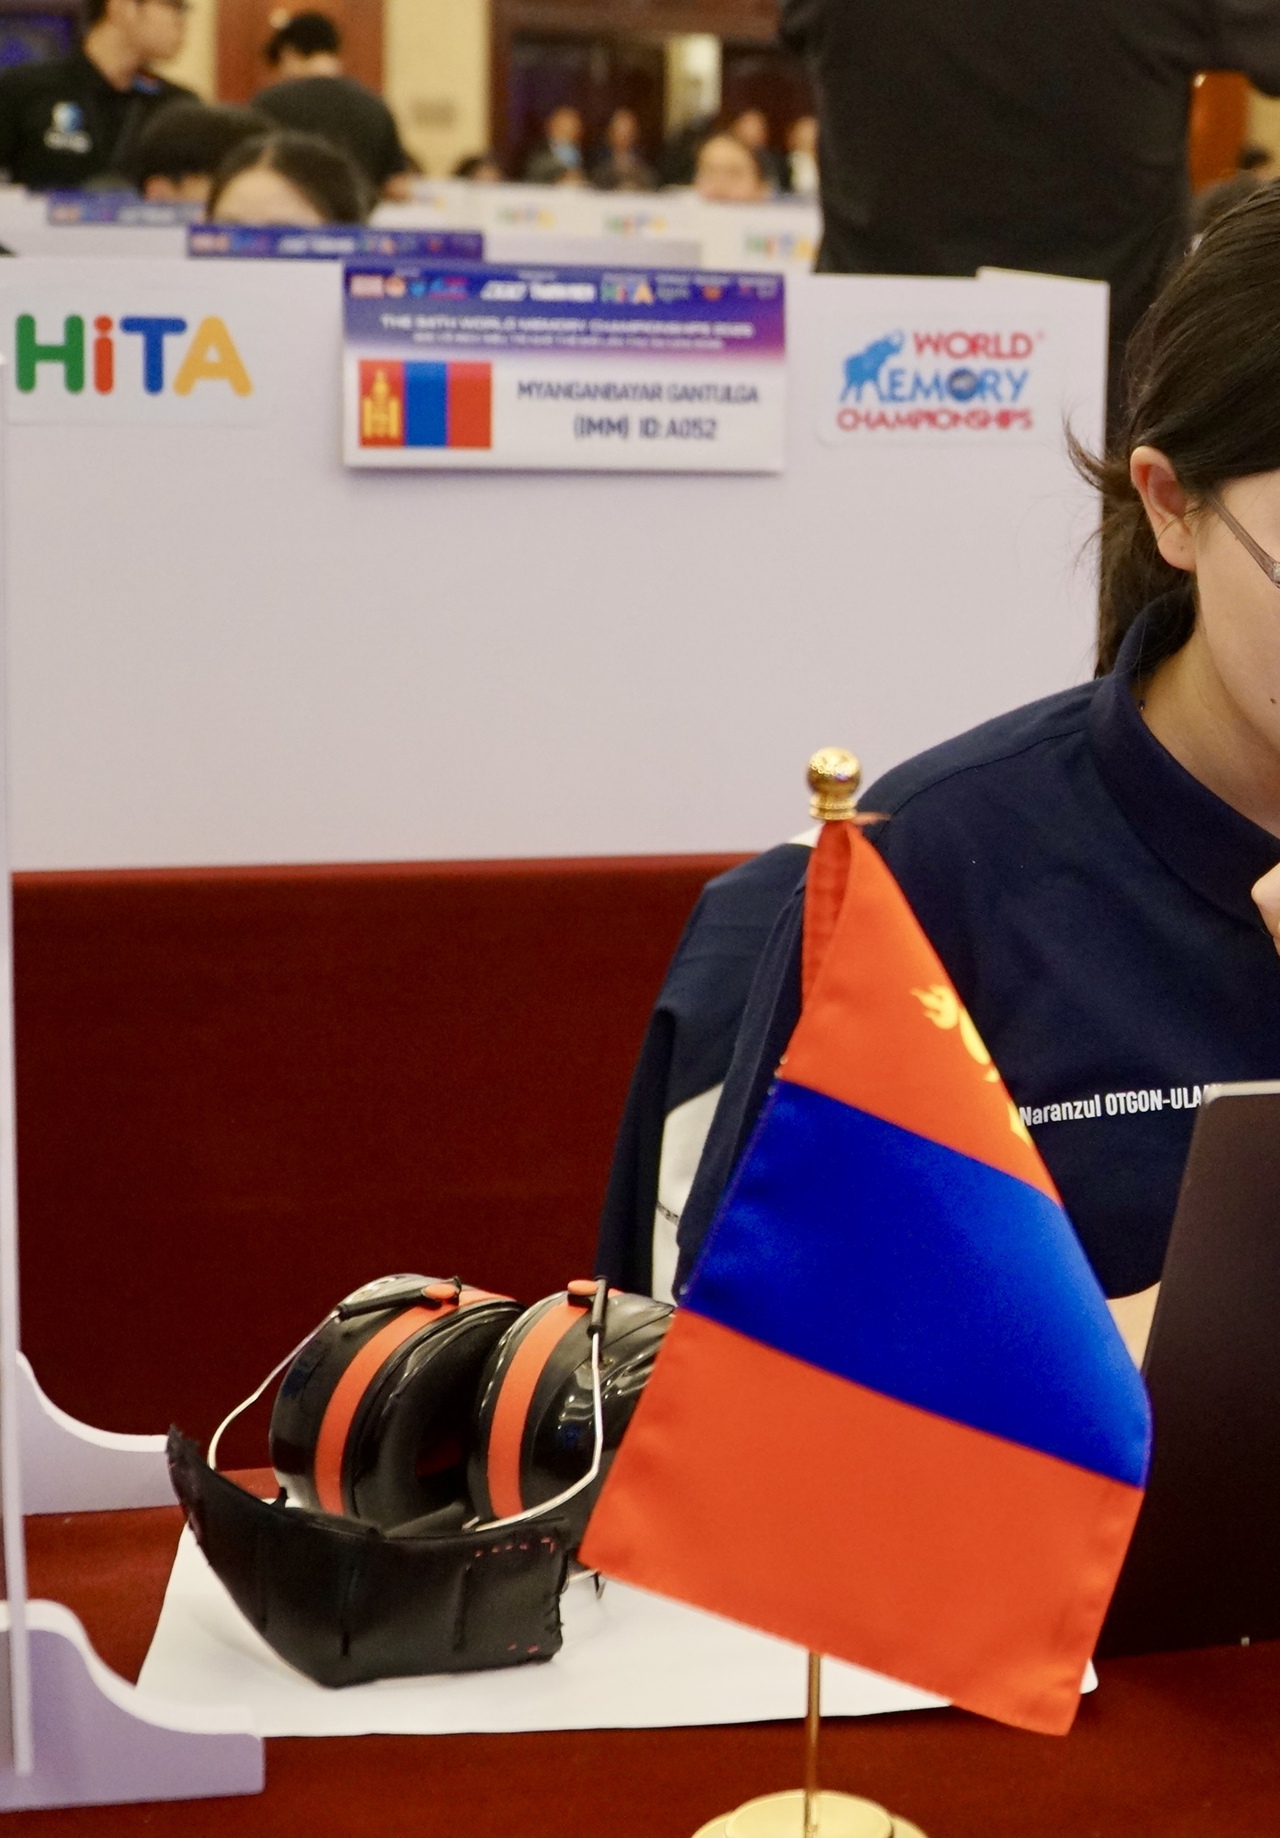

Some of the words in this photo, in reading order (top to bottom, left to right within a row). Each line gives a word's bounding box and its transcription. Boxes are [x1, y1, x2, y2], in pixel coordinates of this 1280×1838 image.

[15, 314, 253, 396] HiTA
[912, 331, 1033, 360] WORLD
[517, 380, 664, 402] MYANGANBAYAR
[665, 383, 760, 404] GANTULGA
[573, 414, 630, 440] (IMM)
[1019, 1093, 1102, 1127] Naranzul
[1105, 1083, 1216, 1116] OTGON-ULA
